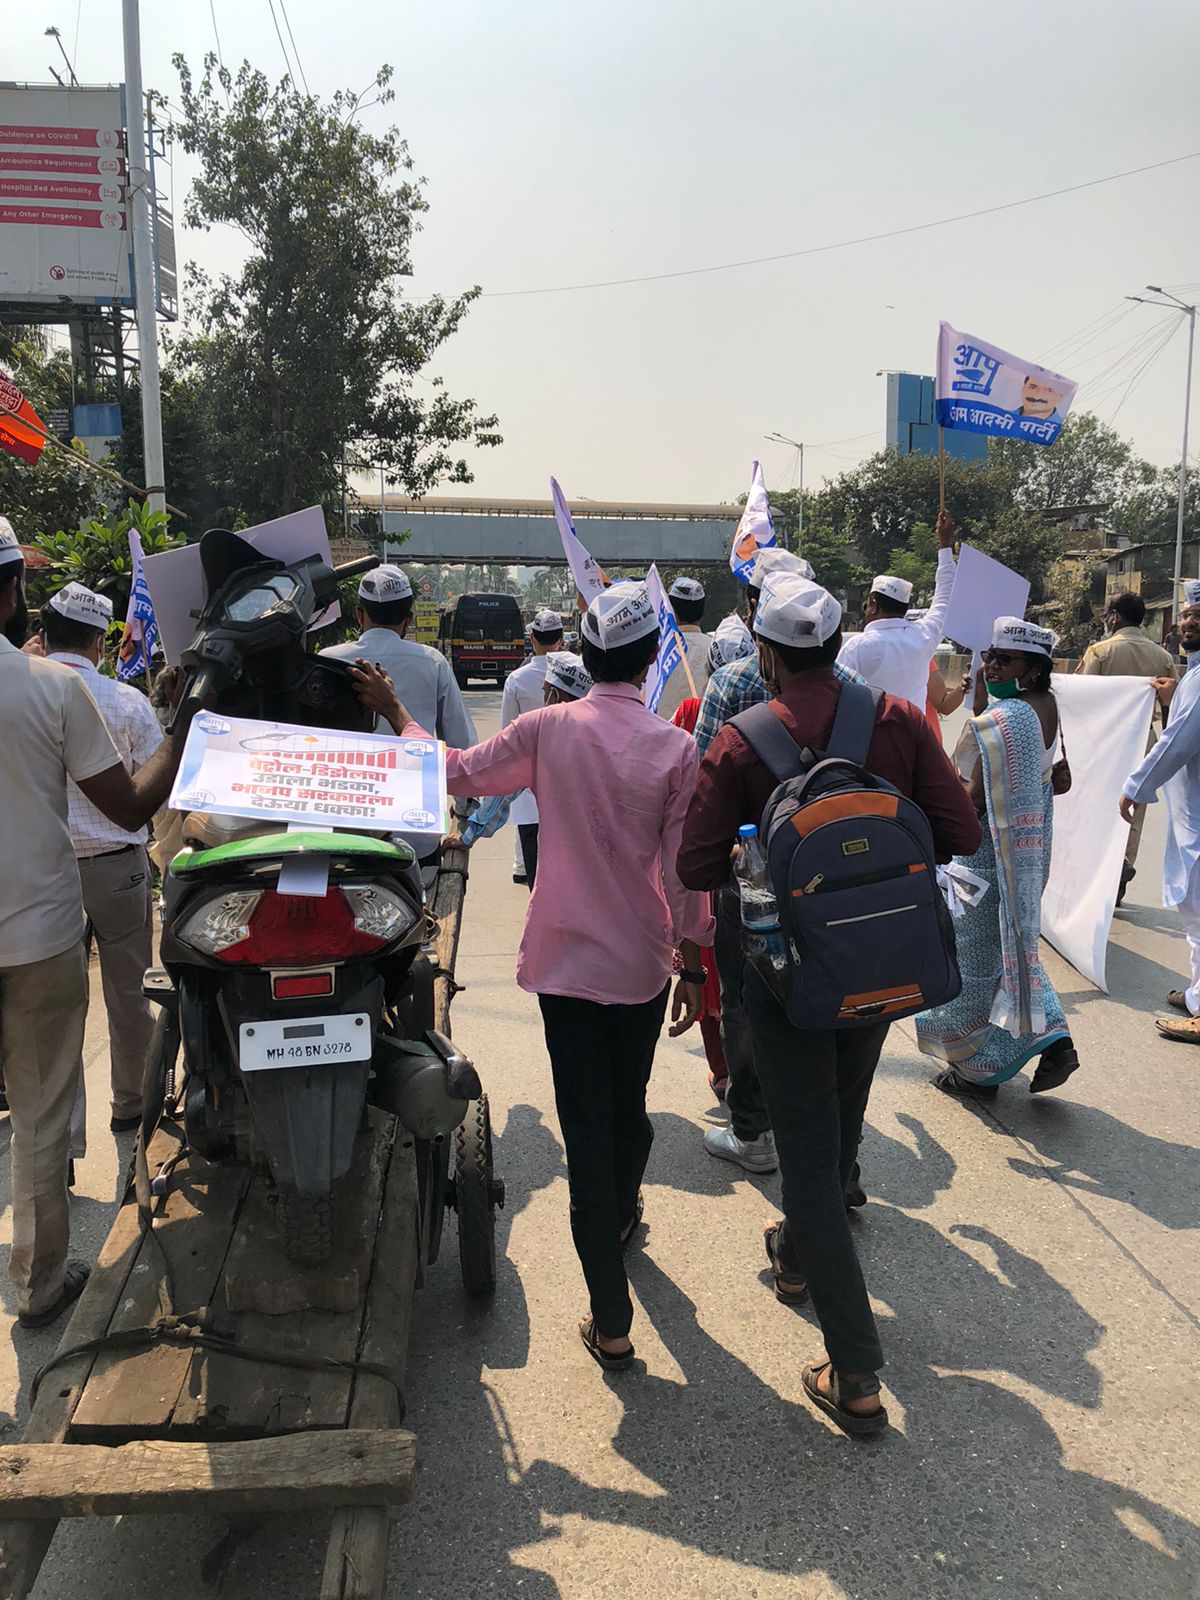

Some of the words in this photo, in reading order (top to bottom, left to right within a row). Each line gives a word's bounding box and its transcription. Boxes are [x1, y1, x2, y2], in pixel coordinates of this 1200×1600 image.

[44, 158, 92, 168] Requirement
[50, 185, 93, 196] Availability
[3, 210, 17, 218] Any
[41, 211, 82, 221] Emergency
[953, 344, 1001, 394] आप
[971, 408, 1015, 431] आदमी
[1020, 421, 1058, 441] पार्टी
[71, 591, 96, 605] आम
[606, 606, 633, 627] आम
[1003, 625, 1027, 636] आम
[252, 772, 313, 787] उडाला
[231, 782, 292, 798] भाजप
[296, 788, 395, 807] सरकारला
[266, 1047, 285, 1061] MH
[287, 1046, 303, 1058] 48
[305, 1044, 322, 1058] BN
[323, 1042, 352, 1055] 3278
